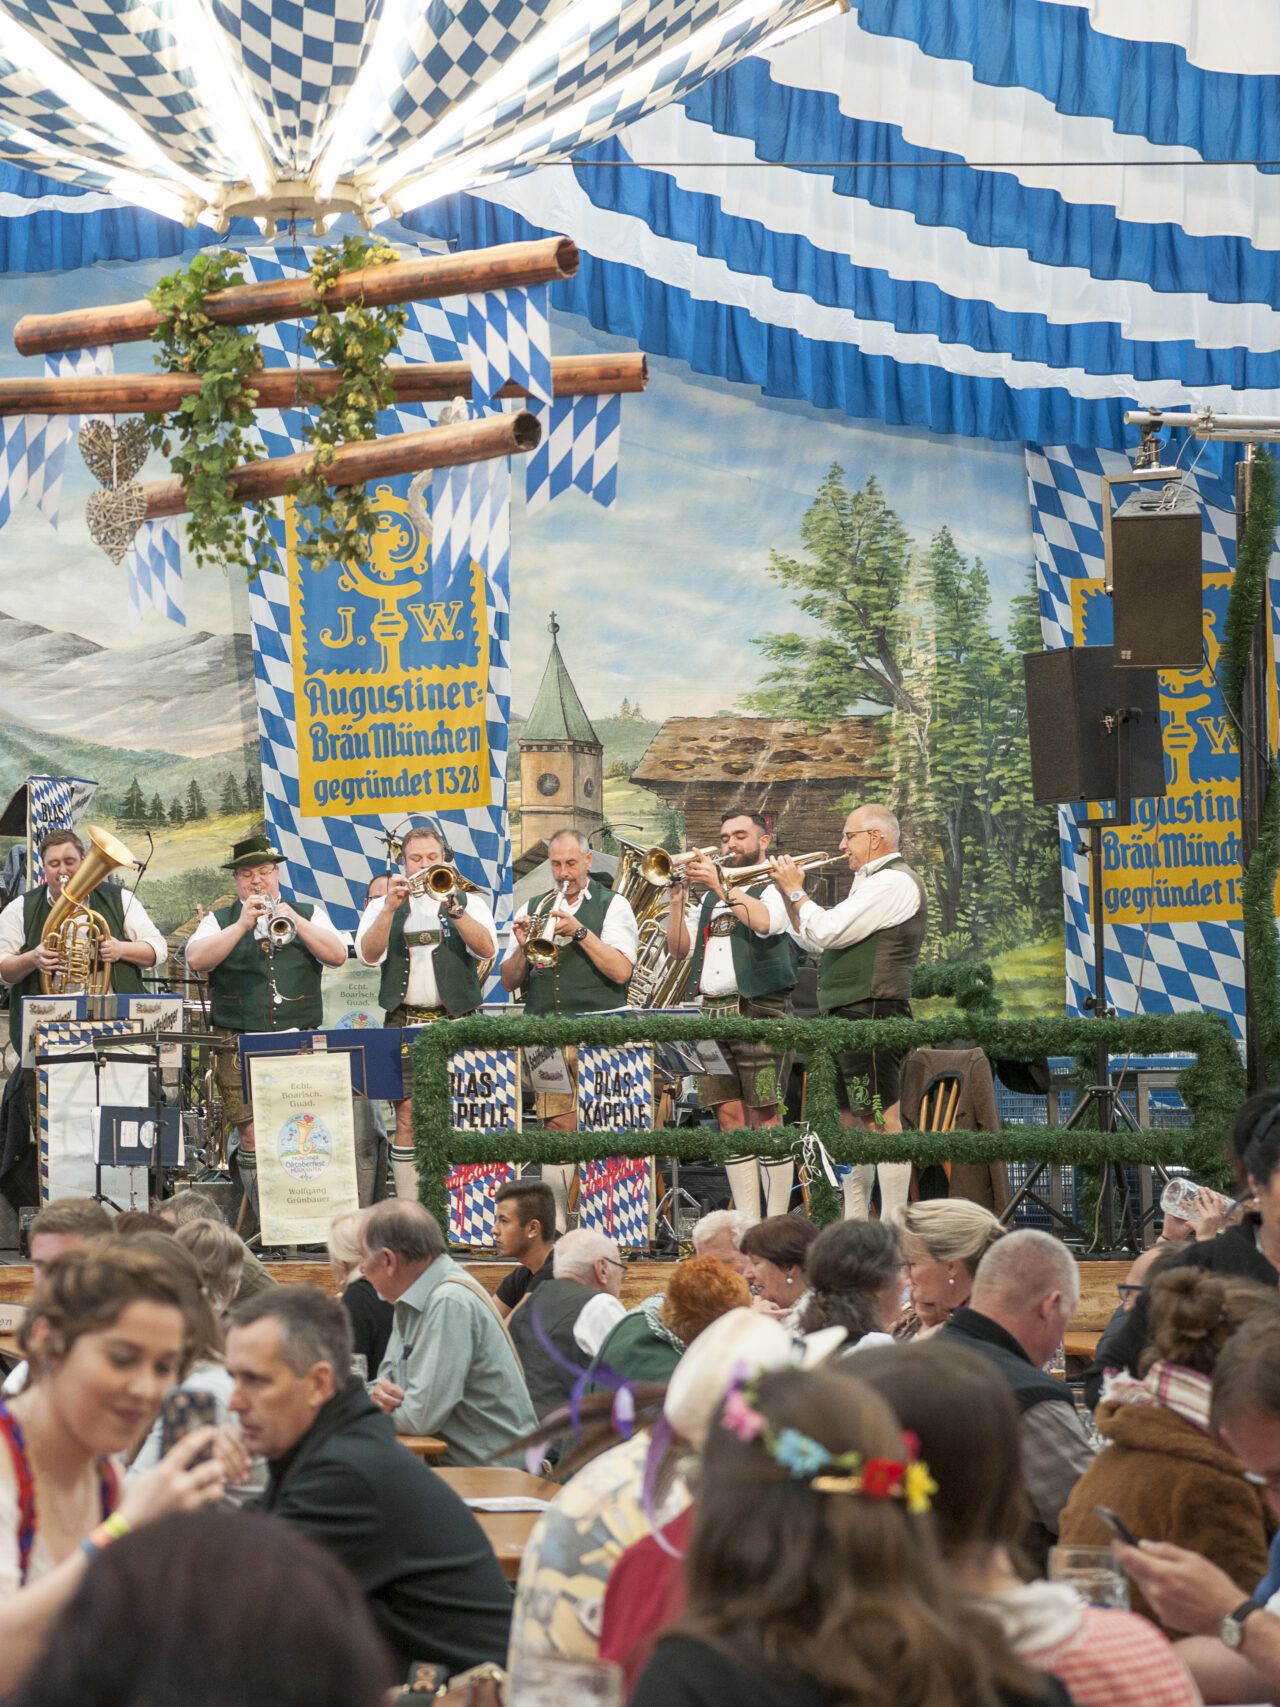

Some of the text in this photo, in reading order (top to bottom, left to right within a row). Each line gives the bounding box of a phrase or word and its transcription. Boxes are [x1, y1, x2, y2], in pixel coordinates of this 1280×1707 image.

[320, 601, 464, 648] J. W.
[308, 720, 481, 762] Bräu München
[313, 765, 480, 807] gegründet 1328
[1102, 831, 1161, 871] Bräu
[1104, 878, 1223, 914] gegründet
[281, 1092, 323, 1100] Boarisch.
[290, 1082, 312, 1090] Echt.
[594, 1071, 638, 1097] BLAS-
[582, 1102, 646, 1129] KAPELLE
[285, 1160, 326, 1168] Oktoberfest
[288, 1187, 327, 1195] Wolfgang
